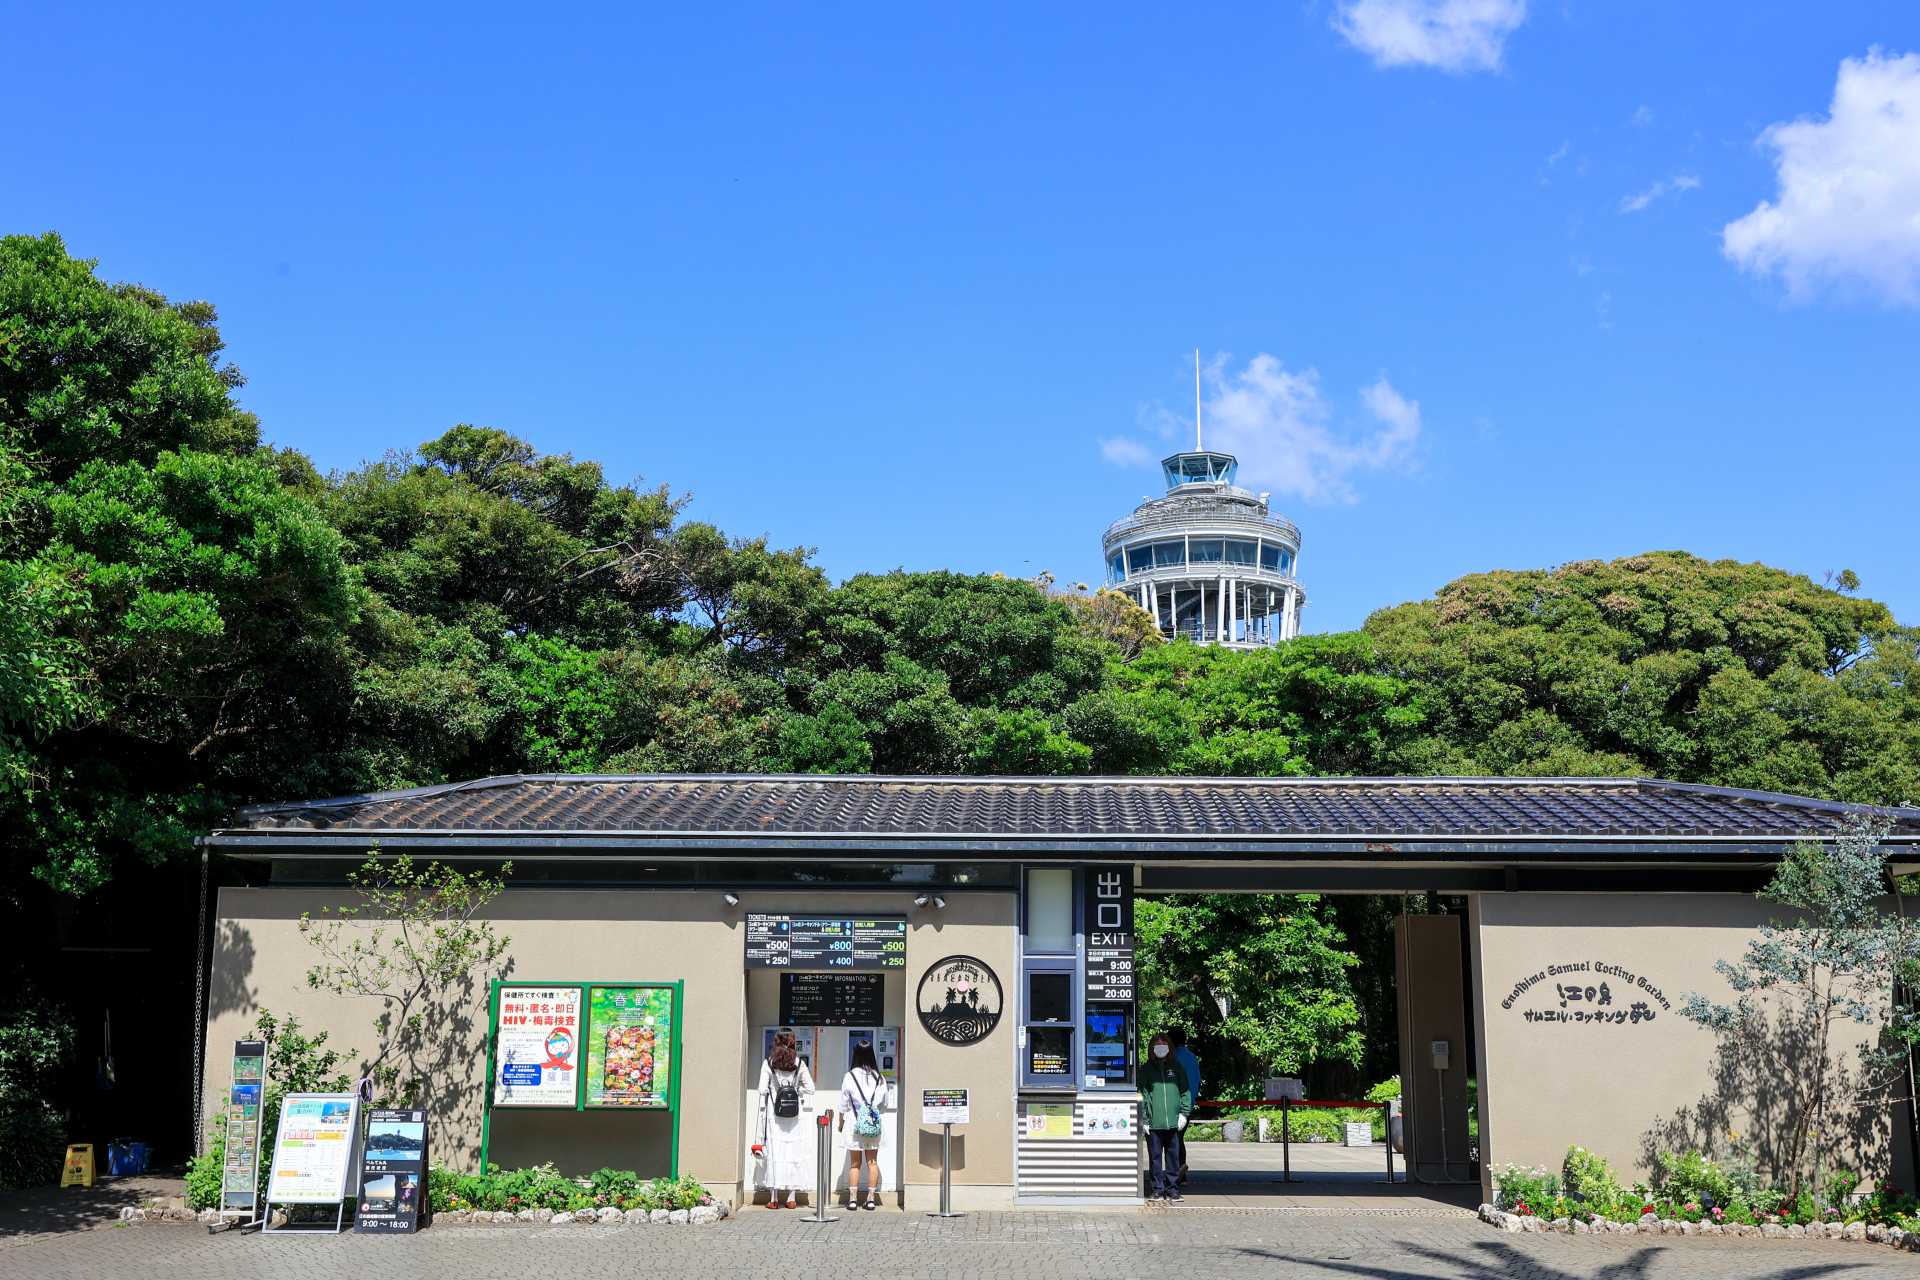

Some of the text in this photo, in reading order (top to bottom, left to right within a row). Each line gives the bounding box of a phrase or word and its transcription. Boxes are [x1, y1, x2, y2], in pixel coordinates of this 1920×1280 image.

[1097, 872, 1122, 928] 出口
[1091, 932, 1128, 945] EXIT
[1110, 961, 1132, 970] 9:00
[1105, 975, 1132, 984] 19:30
[1547, 960, 1591, 976] Samuel
[1594, 960, 1636, 984] Cocking
[1636, 975, 1672, 1011] Garden
[1105, 989, 1132, 998] 20:00
[1556, 981, 1612, 1008] 江の島
[362, 1220, 378, 1228] 9:00
[389, 1220, 409, 1229] 18:00
